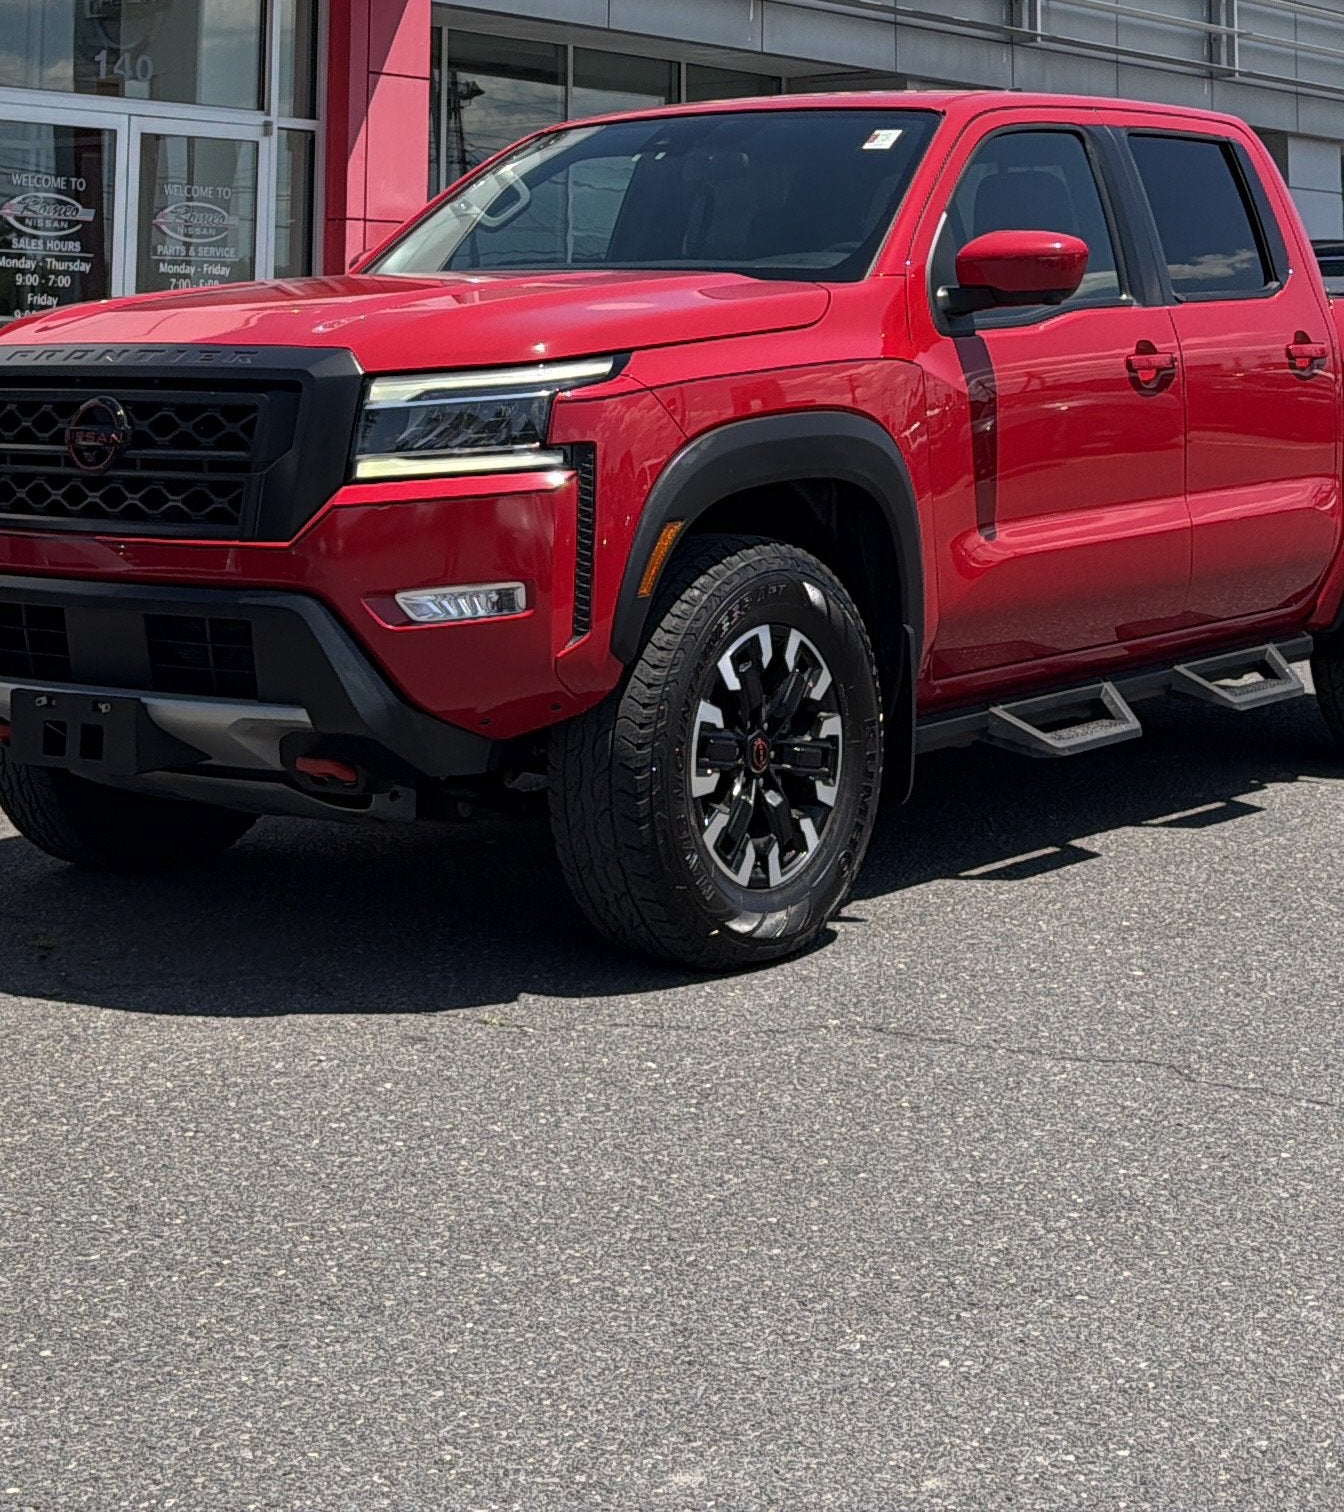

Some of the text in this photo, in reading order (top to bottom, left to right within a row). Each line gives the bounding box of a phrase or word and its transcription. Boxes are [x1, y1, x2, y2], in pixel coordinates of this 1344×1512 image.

[94, 49, 154, 83] 140
[11, 172, 87, 192] WELCOME TO
[164, 183, 232, 200] WELCOME TO
[21, 195, 80, 218] Romeo
[169, 204, 226, 225] Romeo
[24, 218, 69, 229] NISSAN
[176, 225, 216, 236] NISSAN
[11, 237, 81, 253] SALES HOURS
[157, 244, 187, 256] PARTS
[197, 246, 236, 258] SERVICE
[45, 257, 92, 275] Thursday
[158, 261, 196, 276] Monday
[202, 263, 231, 278] Friday
[15, 273, 39, 287] 9:00
[47, 274, 72, 288] 7:00
[27, 293, 59, 308] Friday
[5, 348, 260, 365] FRONTIER
